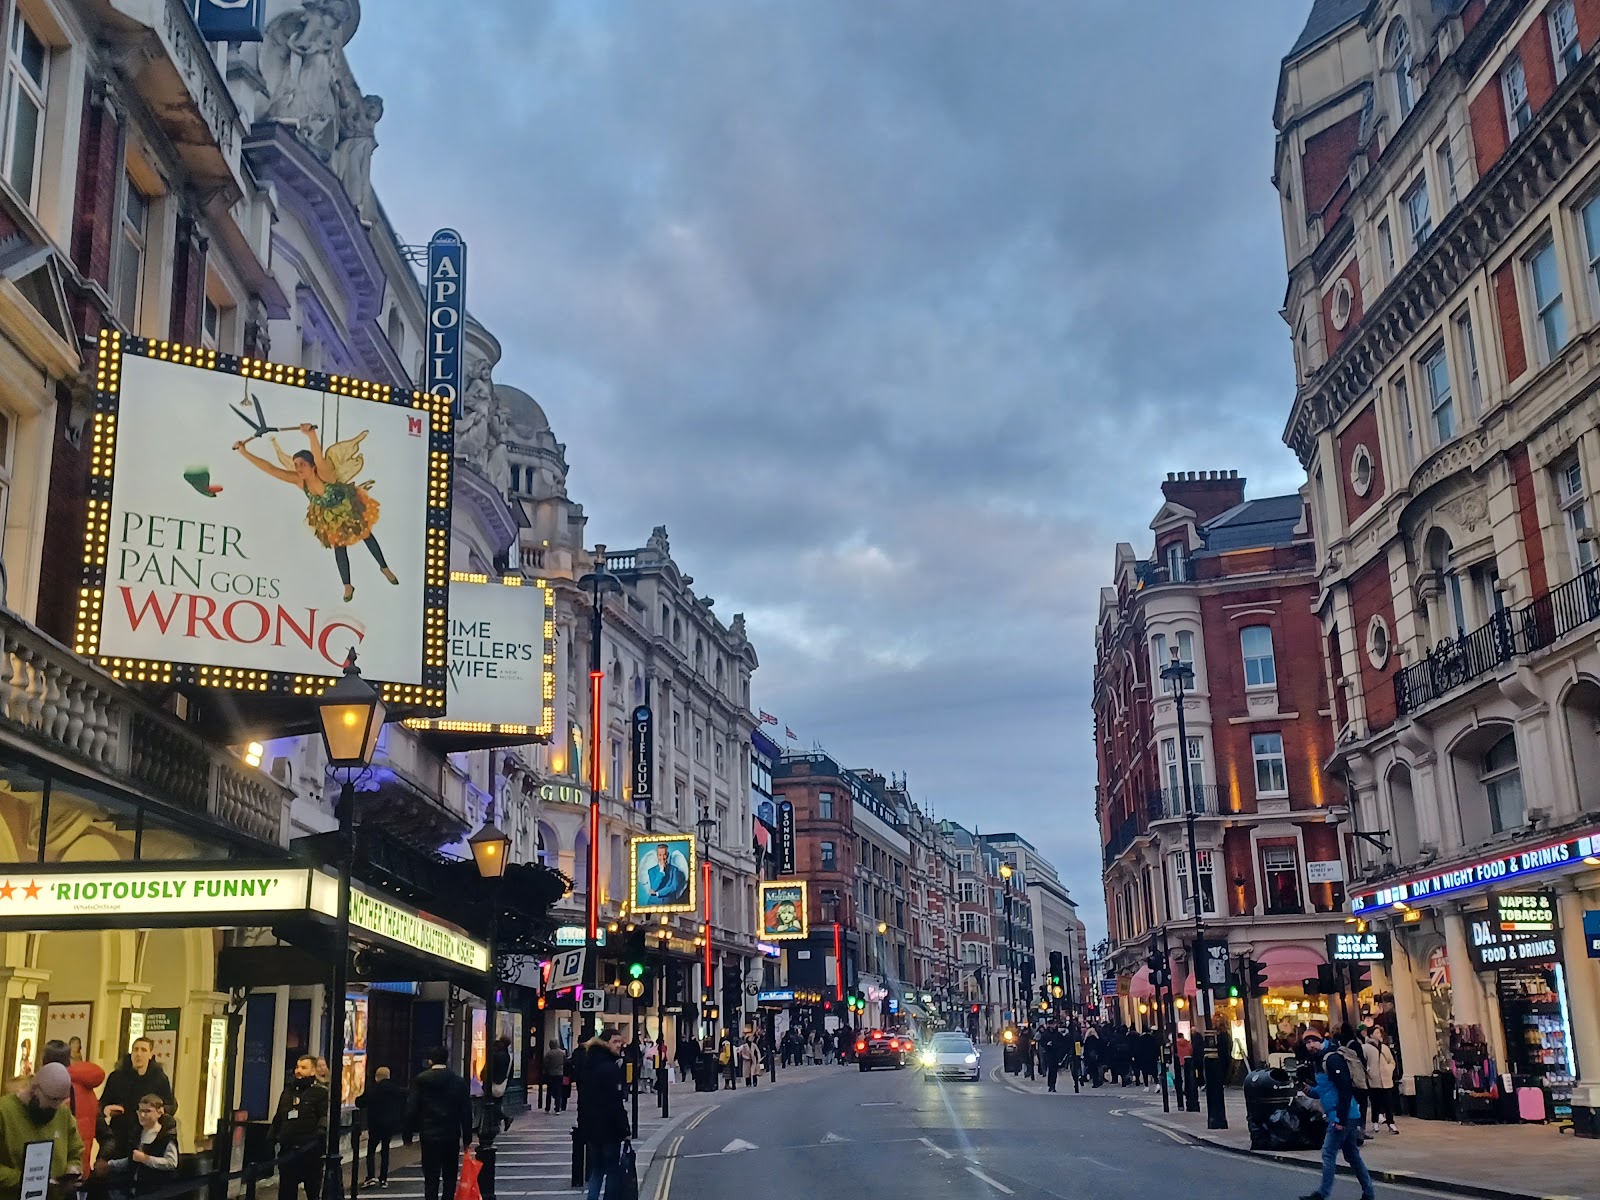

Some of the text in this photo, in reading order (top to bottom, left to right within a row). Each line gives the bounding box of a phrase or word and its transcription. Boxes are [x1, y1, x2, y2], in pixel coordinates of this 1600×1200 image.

[431, 256, 458, 405] APOLLO
[121, 511, 250, 560] PETER
[118, 548, 280, 599] PAN GOES
[117, 585, 365, 669] WRONG
[448, 619, 491, 639] IME
[447, 639, 532, 661] ELLER'S
[637, 722, 648, 794] GIELGUD
[783, 812, 791, 870] SONDHEIM
[1412, 843, 1570, 897] DAY N NIGHT FOOD & DRINKS
[1498, 909, 1553, 921] TOBACCO
[1499, 896, 1549, 908] VAPES &
[1337, 934, 1377, 943] DAY N
[1481, 940, 1556, 963] FOOD & DRINKS
[566, 954, 578, 974] P
